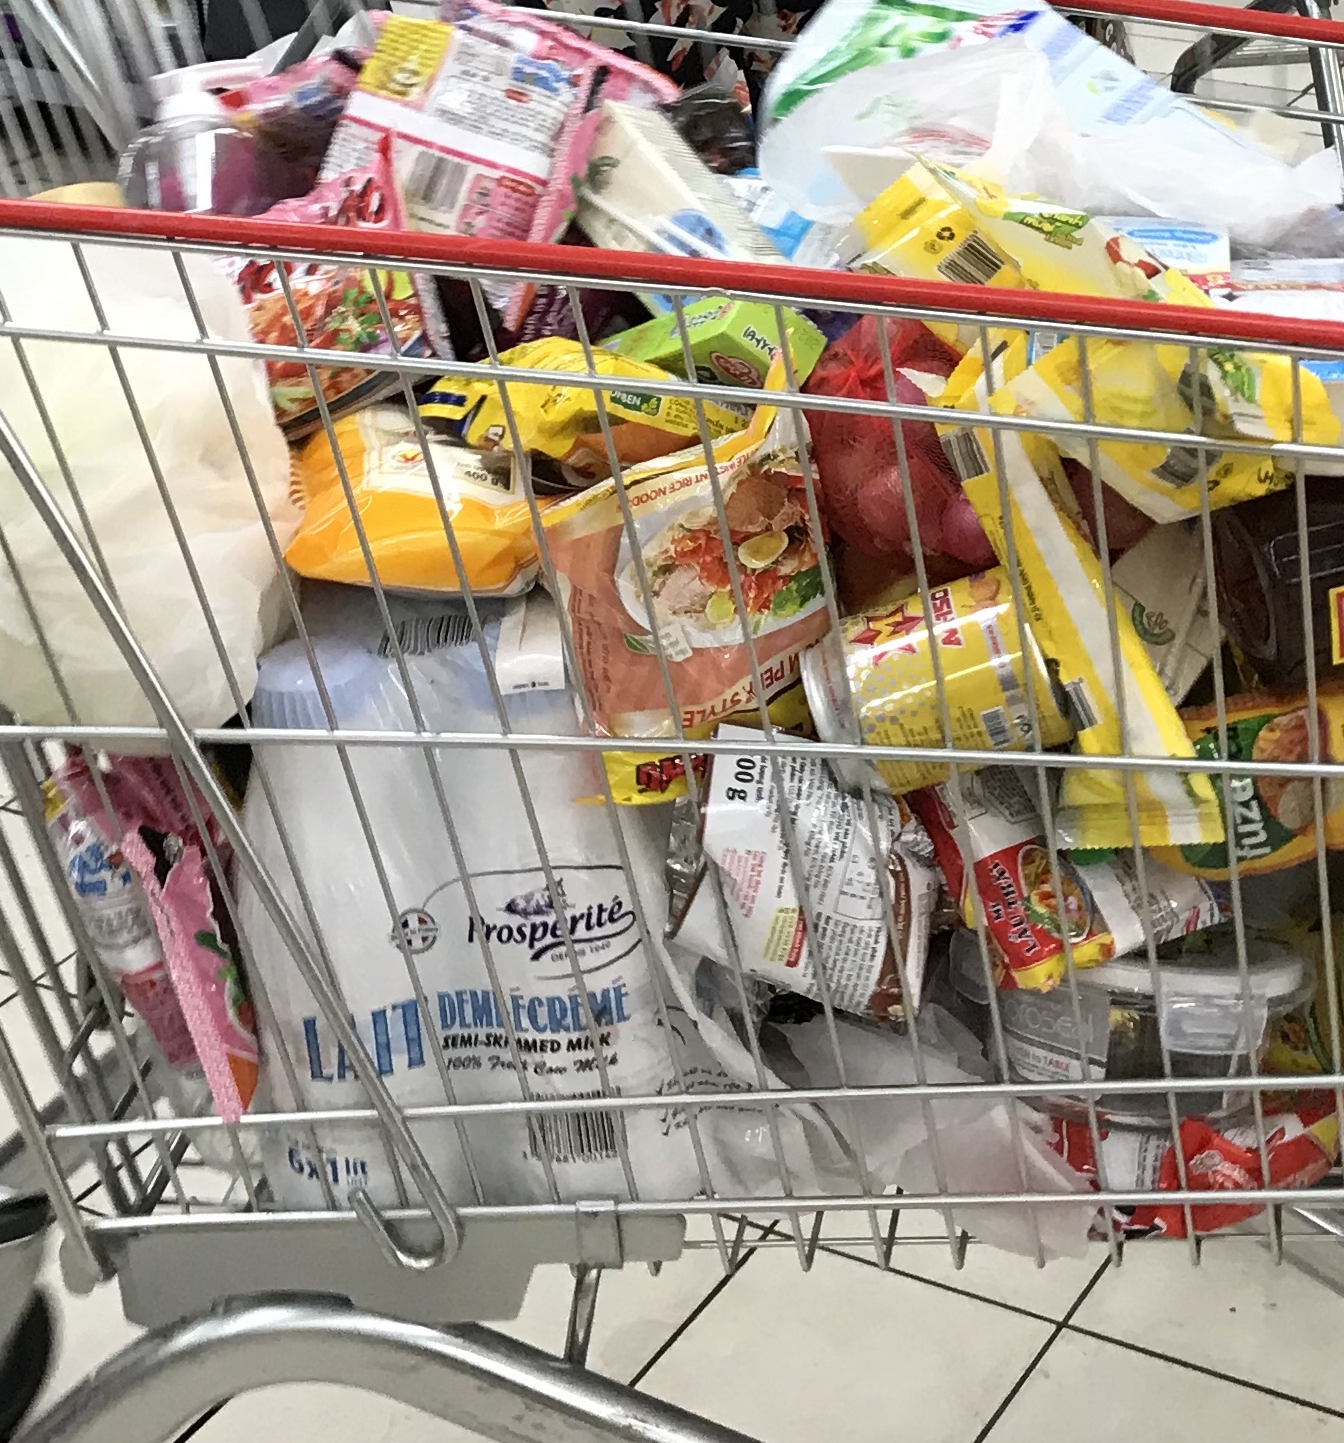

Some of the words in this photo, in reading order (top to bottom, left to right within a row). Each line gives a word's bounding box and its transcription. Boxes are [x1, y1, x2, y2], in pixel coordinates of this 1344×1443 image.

[682, 691, 741, 729] STYLE
[734, 757, 756, 784] 00
[1228, 776, 1272, 858] fuze
[566, 1031, 612, 1052] MIK
